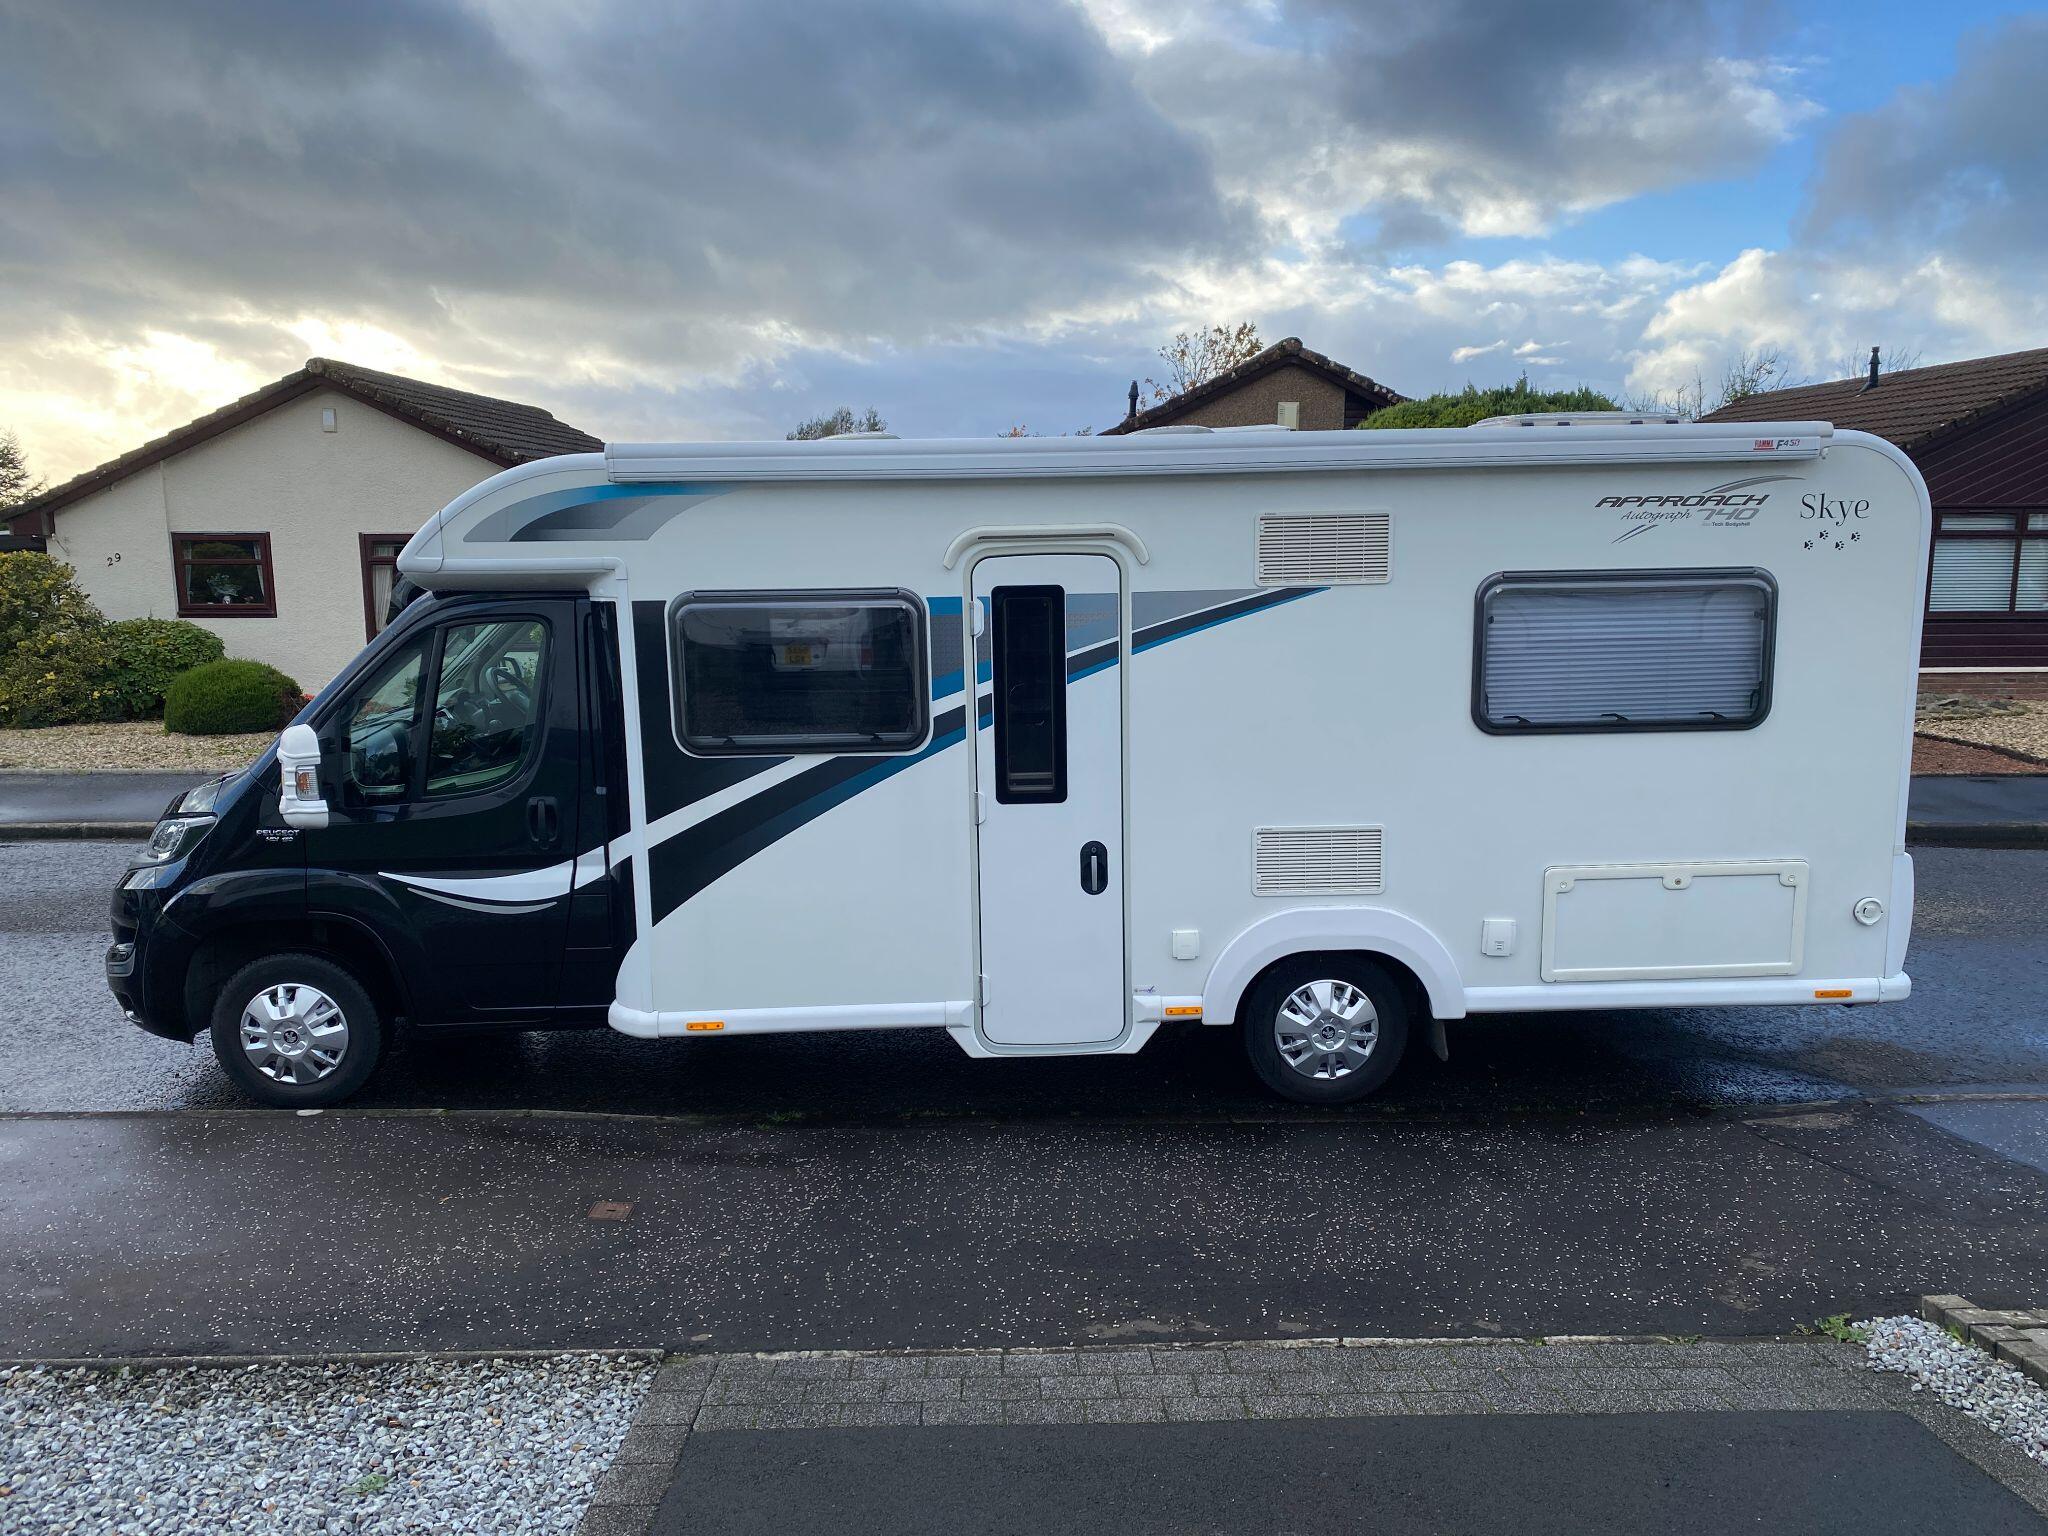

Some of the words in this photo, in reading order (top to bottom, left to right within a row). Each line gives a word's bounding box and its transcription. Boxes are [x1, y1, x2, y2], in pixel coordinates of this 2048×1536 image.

[1754, 439, 1774, 448] FIAMMA
[1594, 494, 1770, 508] APPROACH
[1620, 508, 1693, 523] Autograph
[1697, 507, 1760, 521] 740
[1800, 493, 1871, 527] Skye
[107, 553, 121, 567] 29
